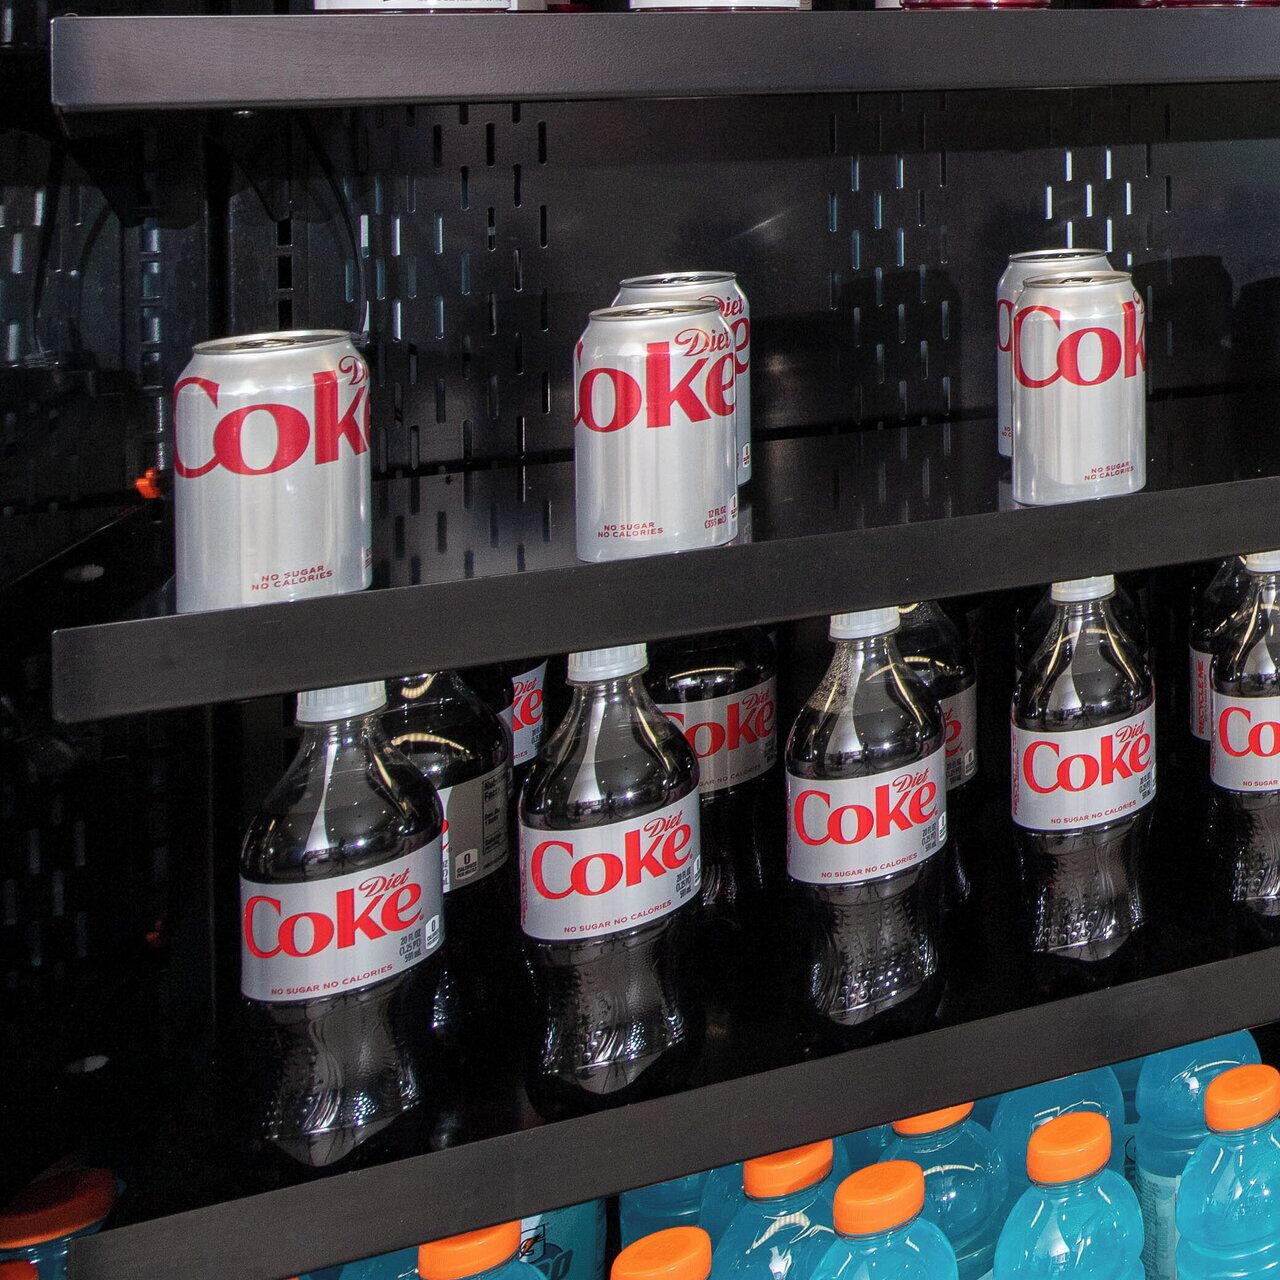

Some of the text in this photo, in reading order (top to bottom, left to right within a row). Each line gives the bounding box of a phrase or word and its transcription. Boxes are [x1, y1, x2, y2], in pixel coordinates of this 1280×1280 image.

[675, 328, 732, 356] Diet
[574, 340, 736, 433] oke
[251, 570, 333, 590] NO CALORIES
[261, 565, 324, 582] NO SUGAR
[893, 767, 930, 794] Diet
[643, 809, 684, 838] Diet
[792, 781, 939, 847] Coke
[531, 823, 692, 900] Coke
[358, 867, 411, 898] Diet
[243, 883, 422, 960] Coke
[271, 964, 393, 996] NO SUGAR NO CALORIES
